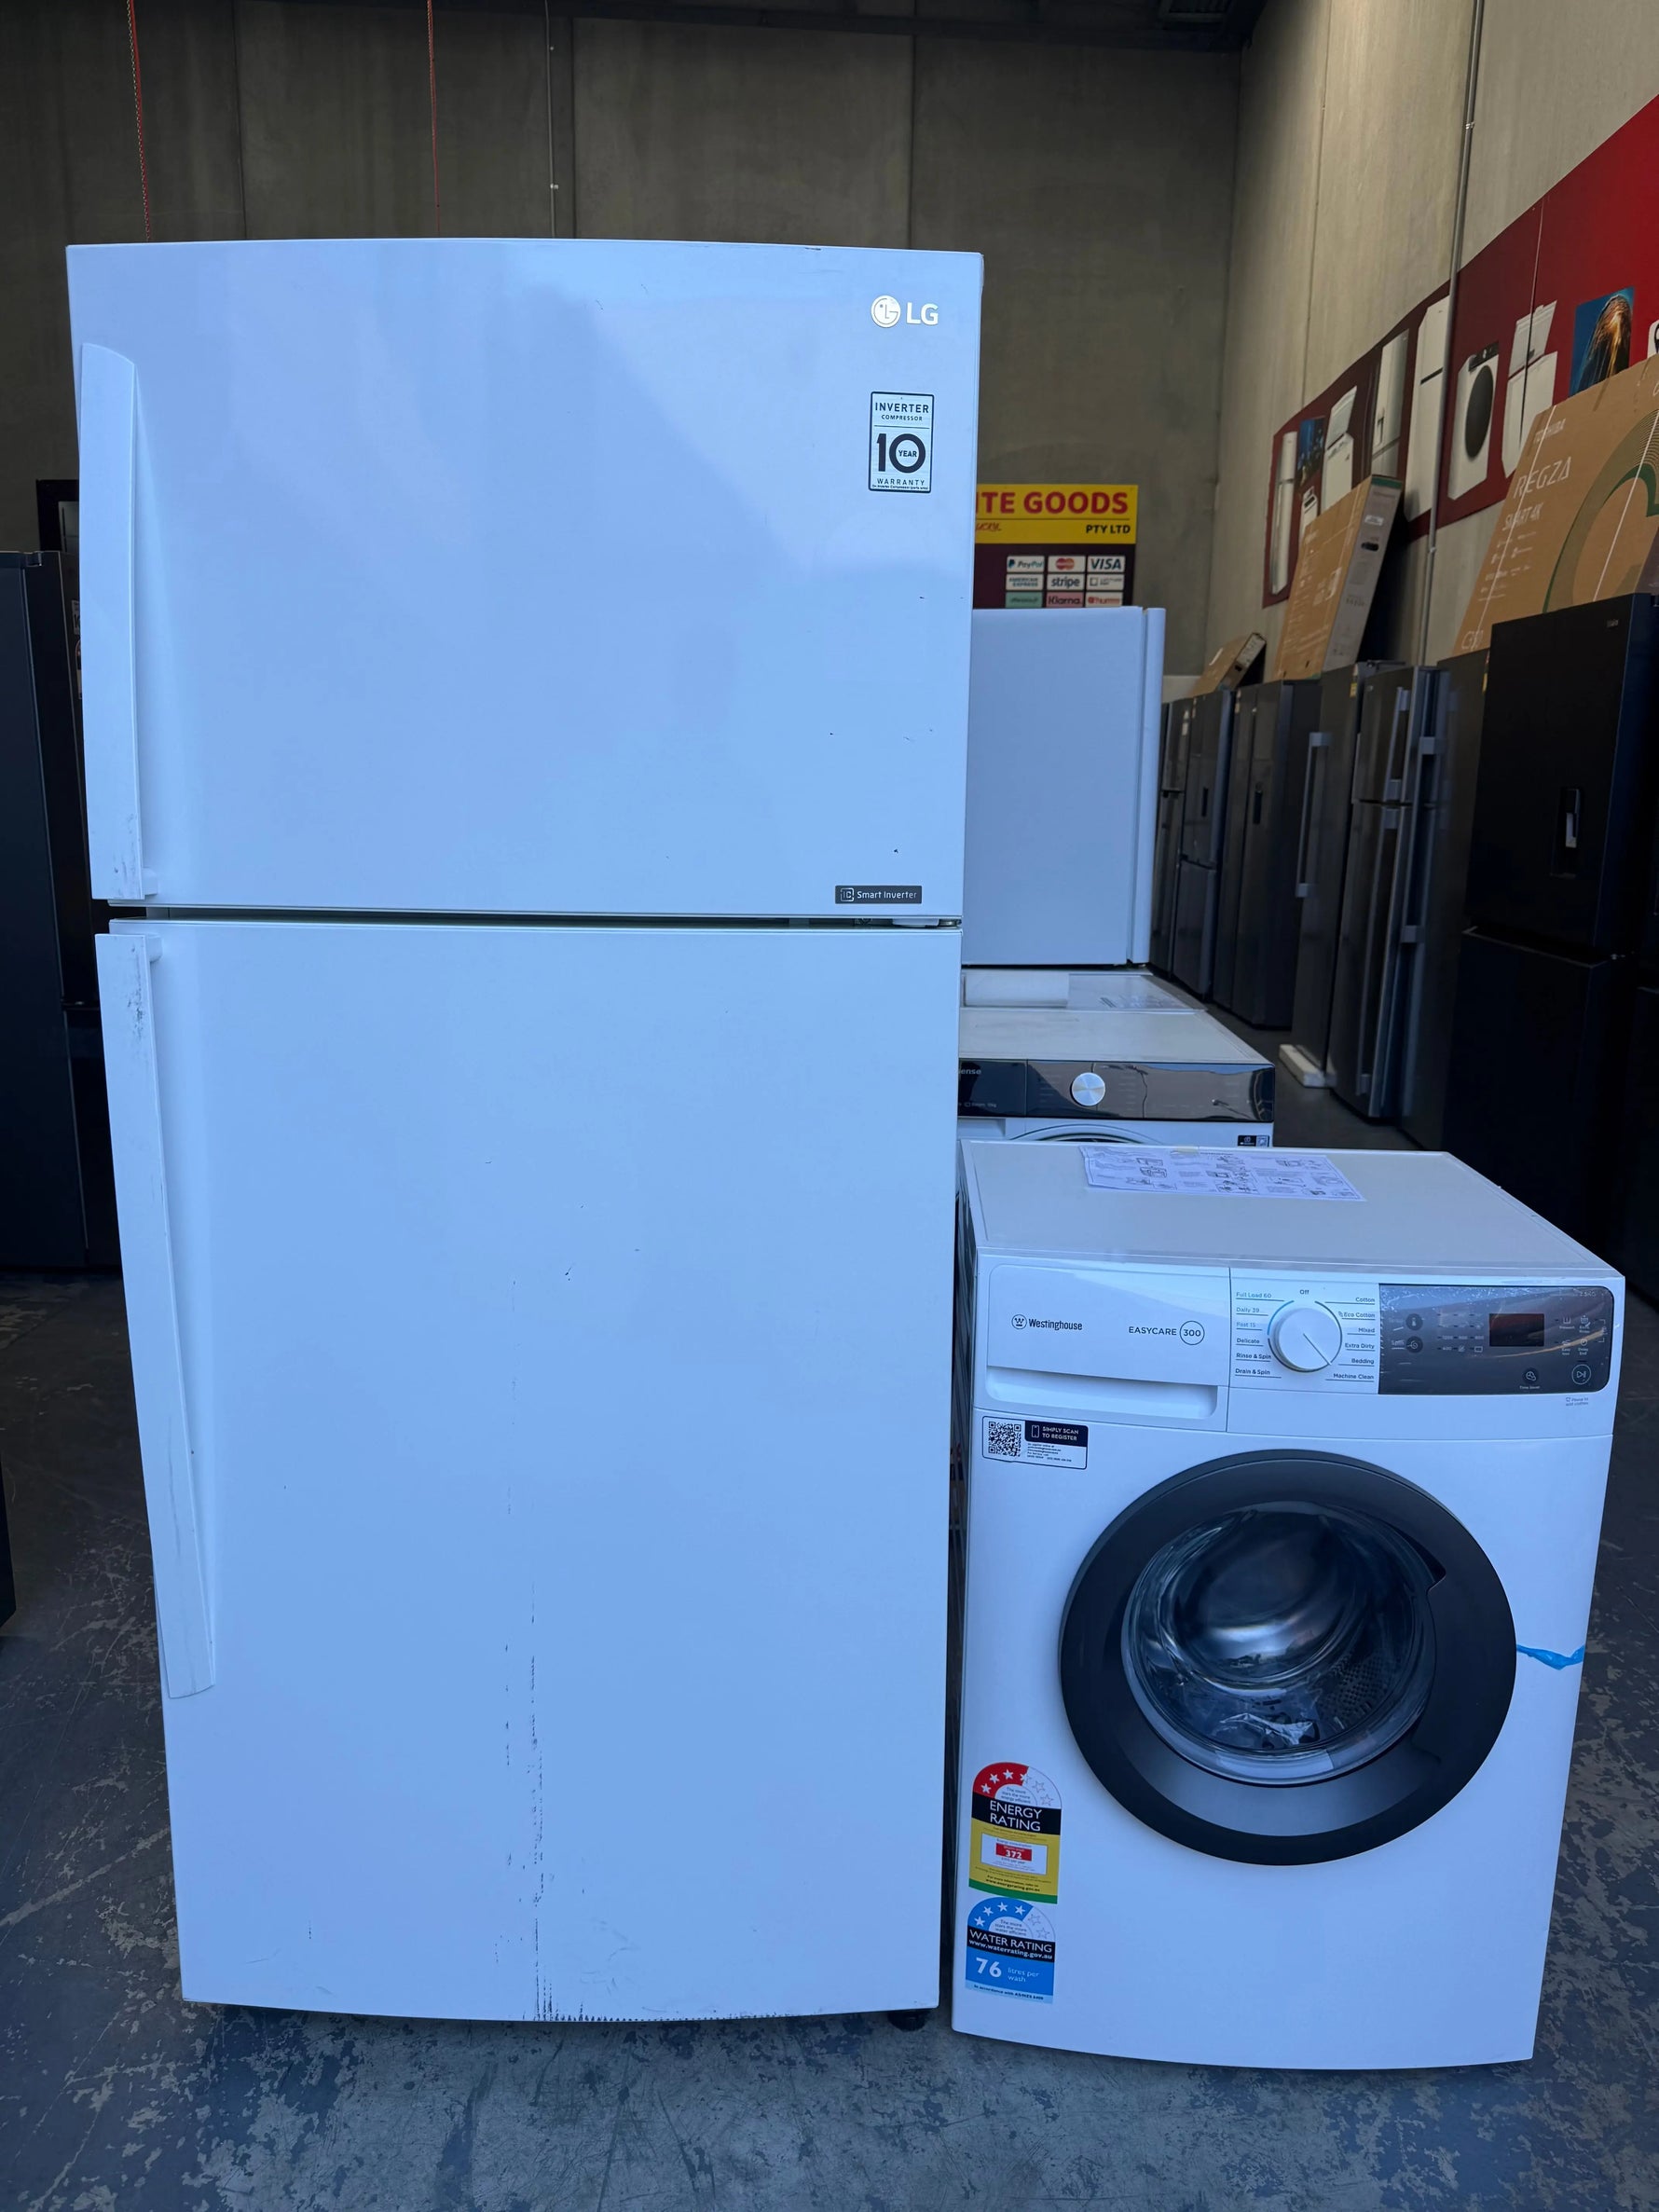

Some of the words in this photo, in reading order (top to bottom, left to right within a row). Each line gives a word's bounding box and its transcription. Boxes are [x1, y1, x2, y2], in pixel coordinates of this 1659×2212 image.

[906, 302, 939, 325] LG
[875, 402, 929, 414] INVERTER
[876, 433, 926, 474] 10
[898, 449, 917, 458] YEAR
[1513, 456, 1571, 499] REGZA
[1023, 491, 1128, 514] GOODS
[1086, 525, 1107, 534] PTY
[1110, 525, 1131, 534] LTD
[1017, 559, 1043, 570] PayPal
[1090, 558, 1121, 570] VISA
[1051, 576, 1080, 589] stripe
[1028, 1318, 1082, 1331] Westinghouse
[1129, 1326, 1177, 1336] EASYCARE
[990, 1801, 1042, 1820] ENERGY
[990, 1812, 1040, 1832] RATING
[1006, 1849, 1021, 1859] 372
[969, 1930, 1008, 1946] WATER
[1010, 1940, 1052, 1953] RATING
[969, 1940, 1052, 1959] www.waterrating.gov.au
[976, 1958, 1002, 1978] 76
[1008, 1967, 1025, 1975] litres
